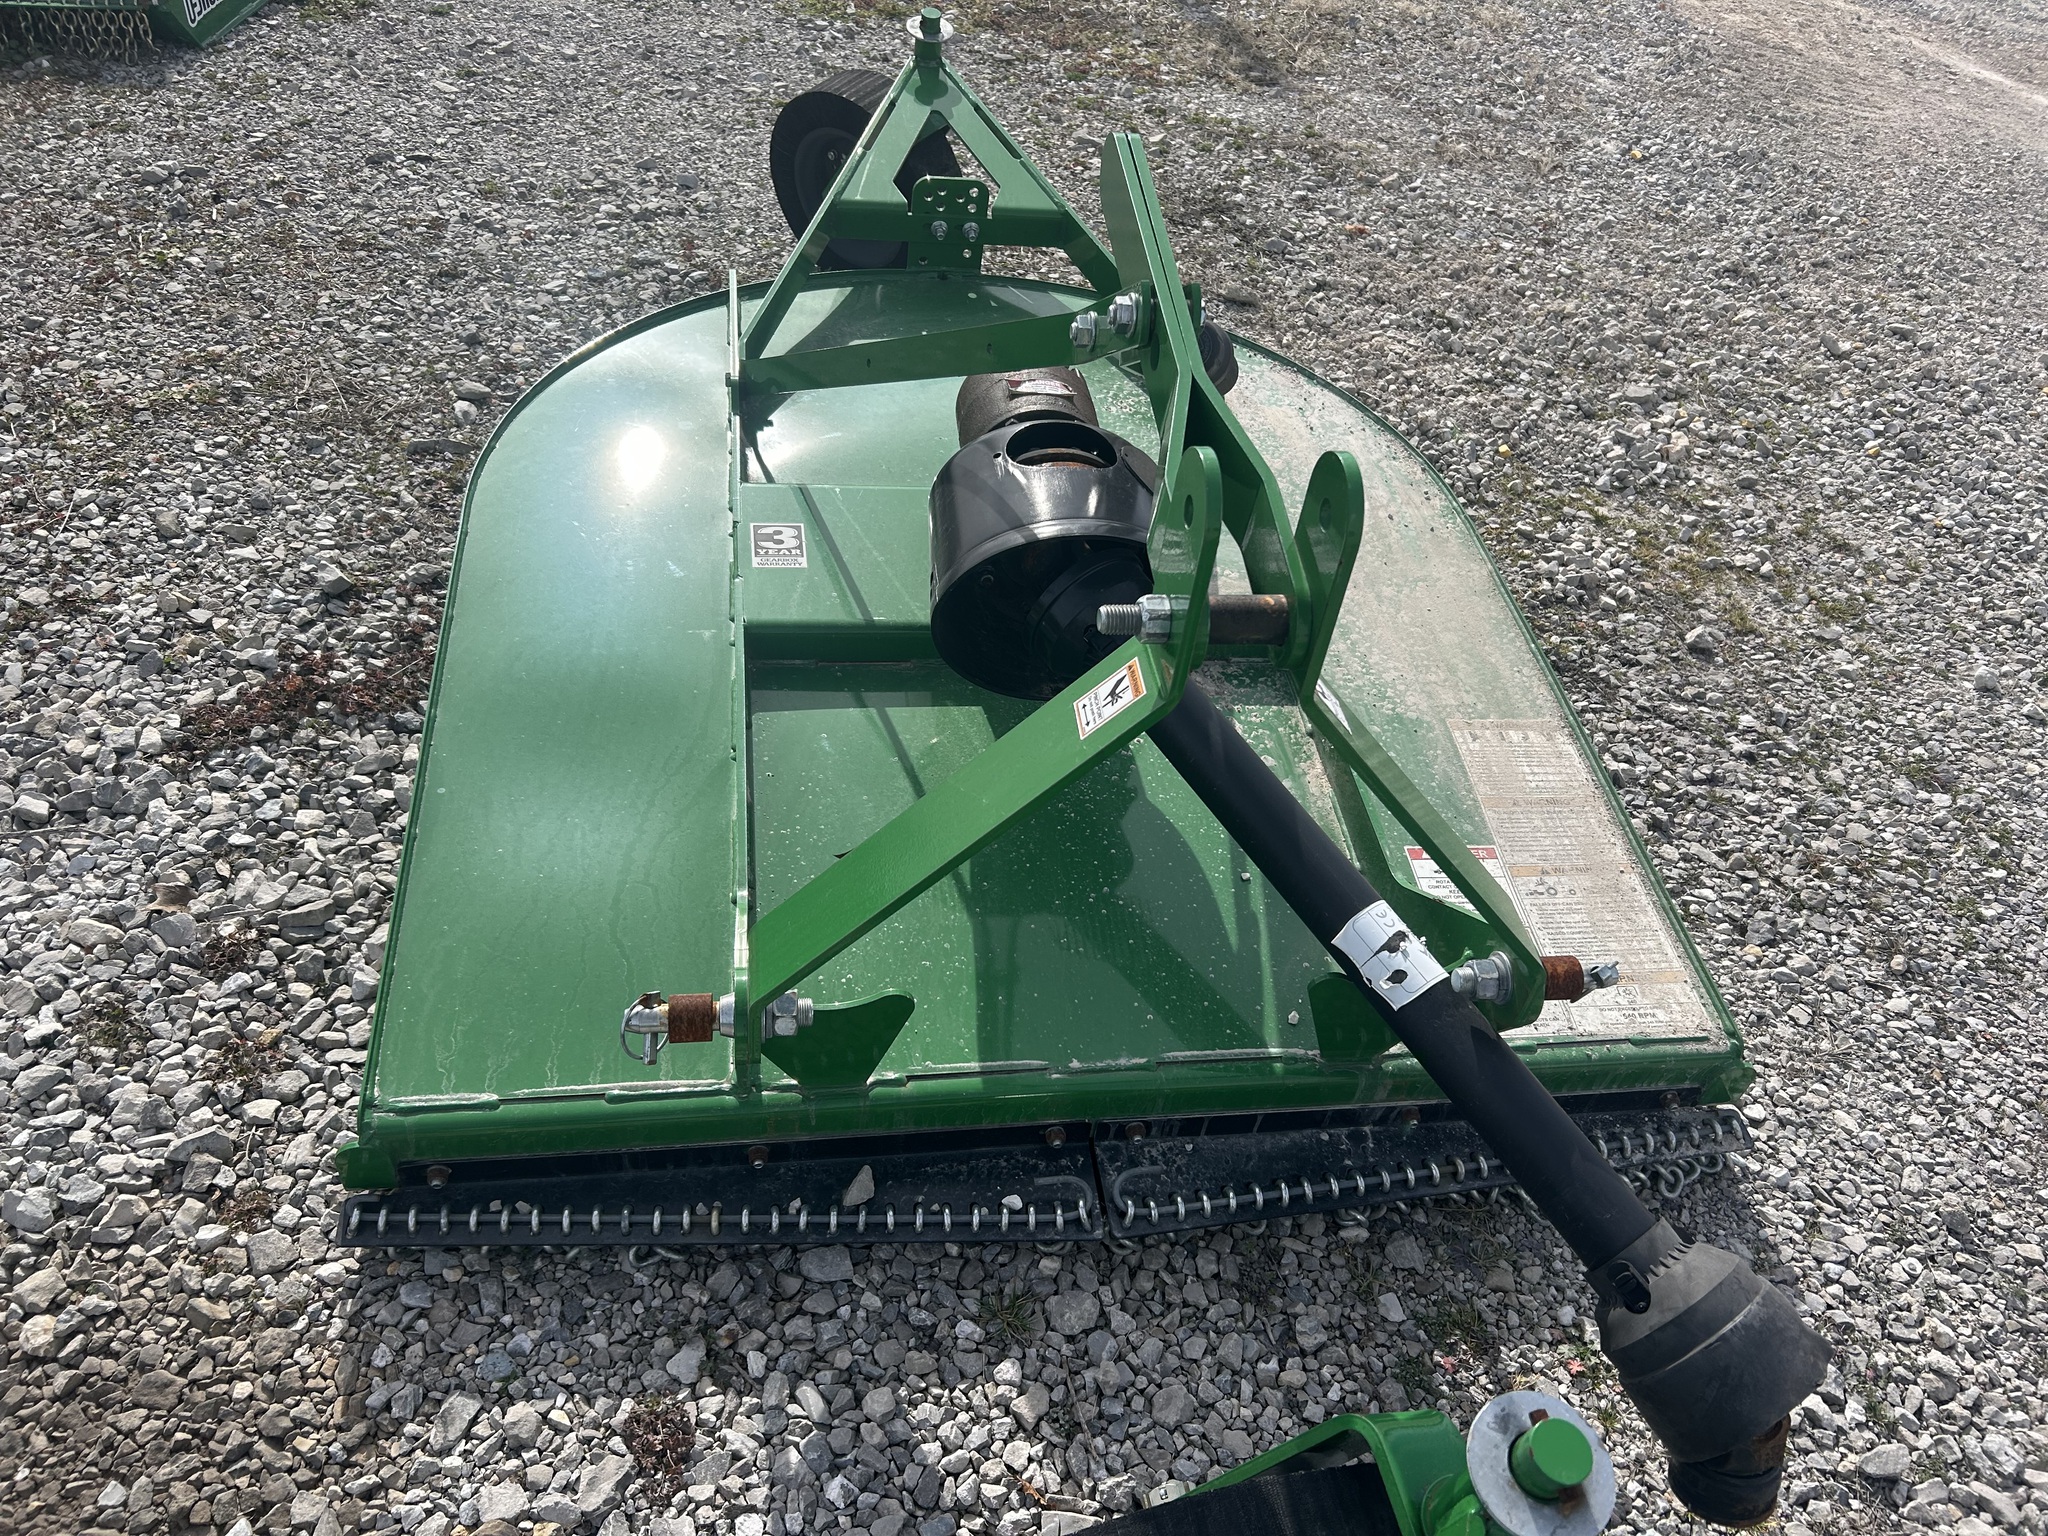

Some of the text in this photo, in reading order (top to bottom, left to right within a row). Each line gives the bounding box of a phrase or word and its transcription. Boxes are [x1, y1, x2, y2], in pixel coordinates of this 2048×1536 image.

[757, 526, 800, 549] 3
[1129, 666, 1141, 699] WARNING
[1622, 1012, 1637, 1020] 540
